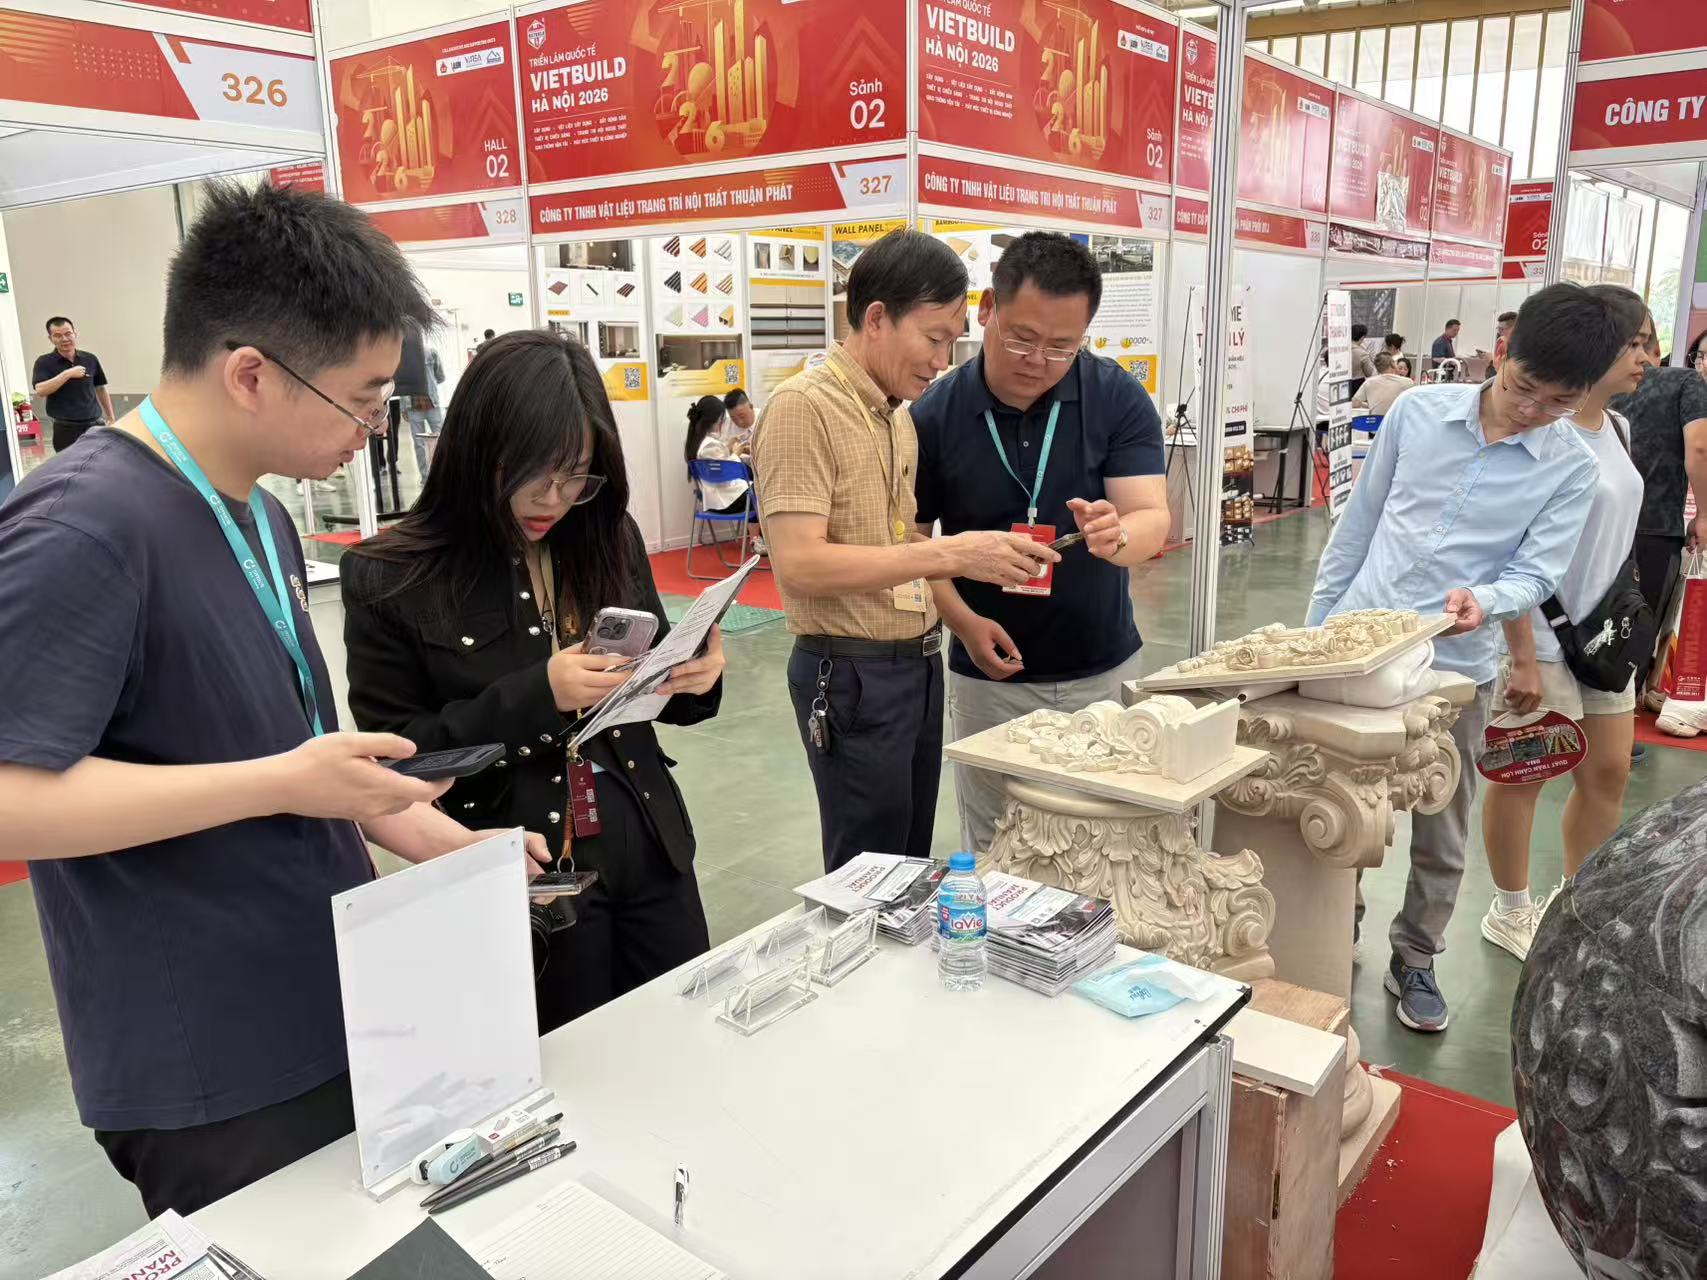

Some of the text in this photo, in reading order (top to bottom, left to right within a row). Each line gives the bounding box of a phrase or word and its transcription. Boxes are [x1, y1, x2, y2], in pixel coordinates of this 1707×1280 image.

[926, 3, 1016, 53] VIETBUILD
[529, 52, 548, 67] TRIỂN
[565, 45, 586, 61] QUỐC
[587, 42, 596, 56] TẾ
[925, 34, 999, 73] HÀ NỘI 2026
[530, 56, 627, 92] VIETBUILD
[849, 78, 883, 96] Sảnh
[221, 73, 288, 107] 326
[532, 87, 609, 113] HÀ NỘI 2026
[1184, 84, 1216, 110] VIETB
[850, 98, 886, 129] 02
[1182, 106, 1194, 123] HÀ
[1605, 95, 1706, 126] CÔNG TY
[484, 138, 508, 152] HALL
[1146, 143, 1163, 169] 02
[486, 154, 509, 178] 02
[860, 174, 893, 195] 327
[925, 171, 948, 192] CÔNG
[949, 178, 960, 194] TY
[961, 179, 982, 198] TNHH
[983, 180, 998, 202] VẬT
[999, 183, 1015, 204] LIỆU
[1016, 188, 1039, 205] TRANG
[540, 182, 793, 223] CÔNG TY TNHH VẬT LIỆU TRANG TRÍ NỘI THẤT THUẬN PHÁT
[1148, 206, 1162, 221] 327
[496, 209, 517, 225] 328
[835, 223, 884, 235] WALL PANEL
[992, 886, 1029, 911] PRODUCT
